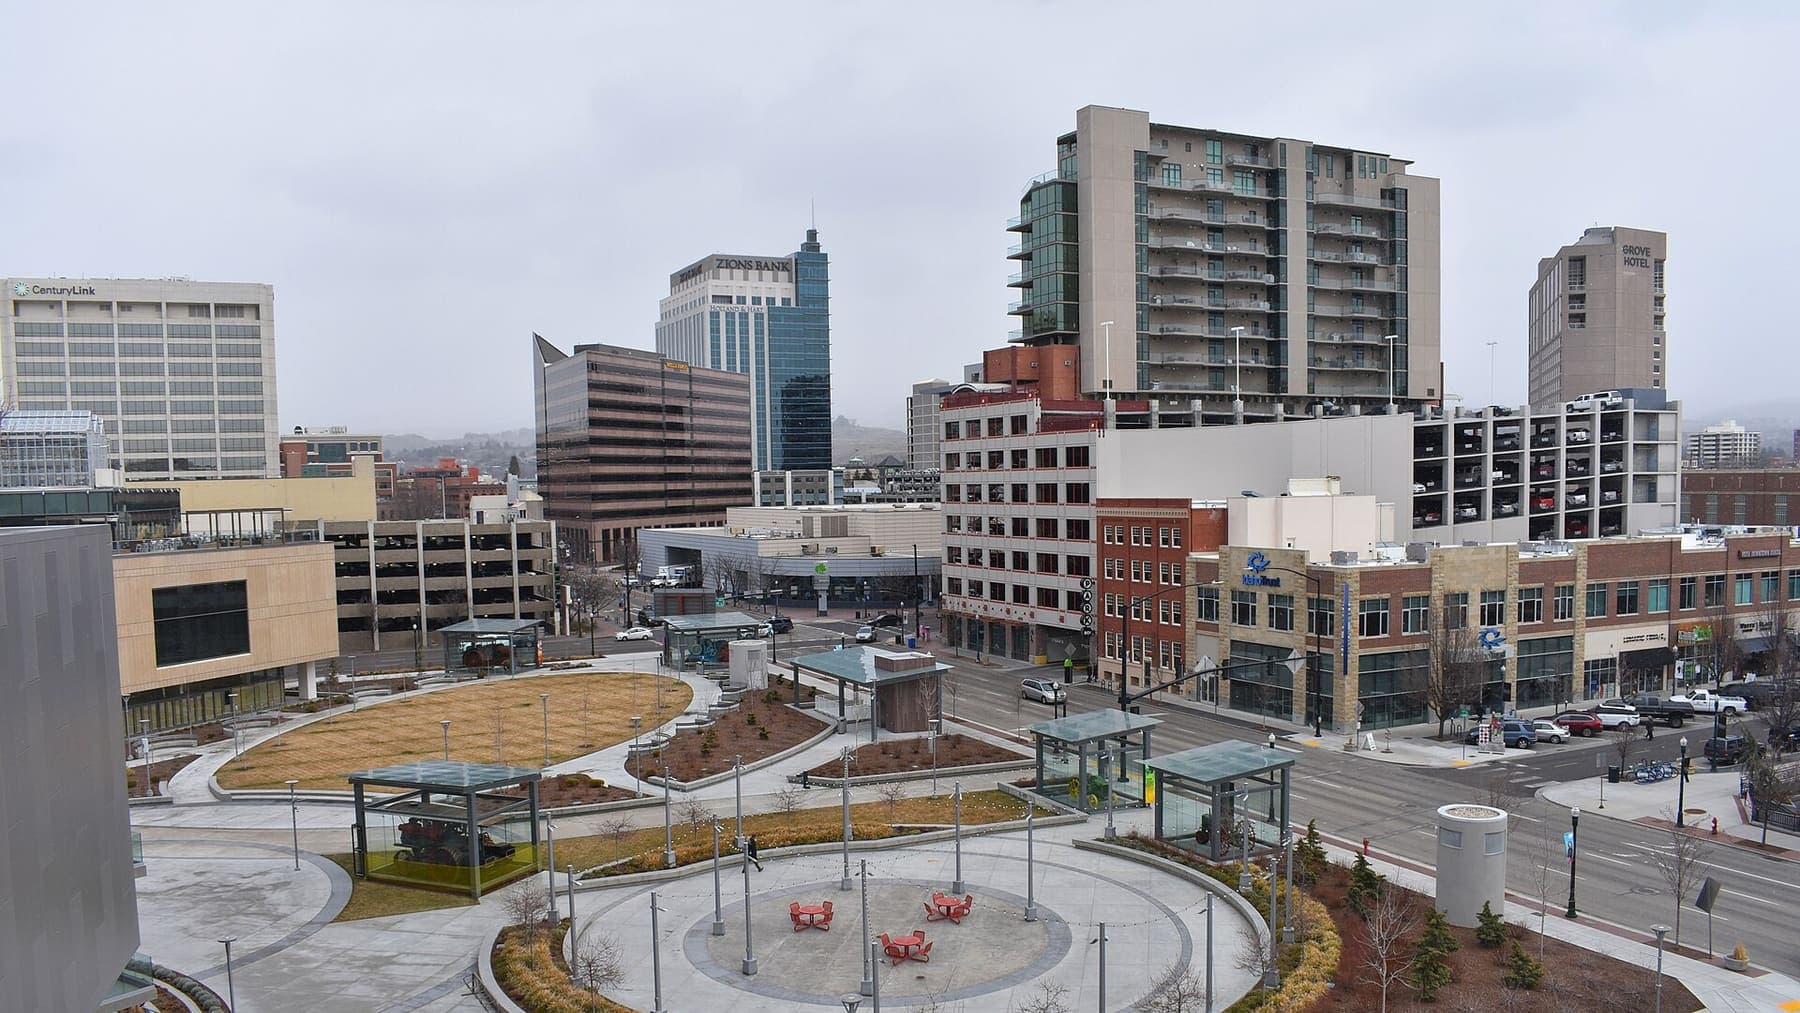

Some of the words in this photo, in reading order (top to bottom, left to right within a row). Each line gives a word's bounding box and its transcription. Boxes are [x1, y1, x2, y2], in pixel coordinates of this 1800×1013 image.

[1622, 245, 1651, 257] GROVE
[716, 258, 753, 270] ZIONS
[755, 260, 791, 272] BANK
[1623, 256, 1650, 269] HOTEL
[32, 284, 96, 296] CenturyLink
[1083, 579, 1092, 626] PARK
